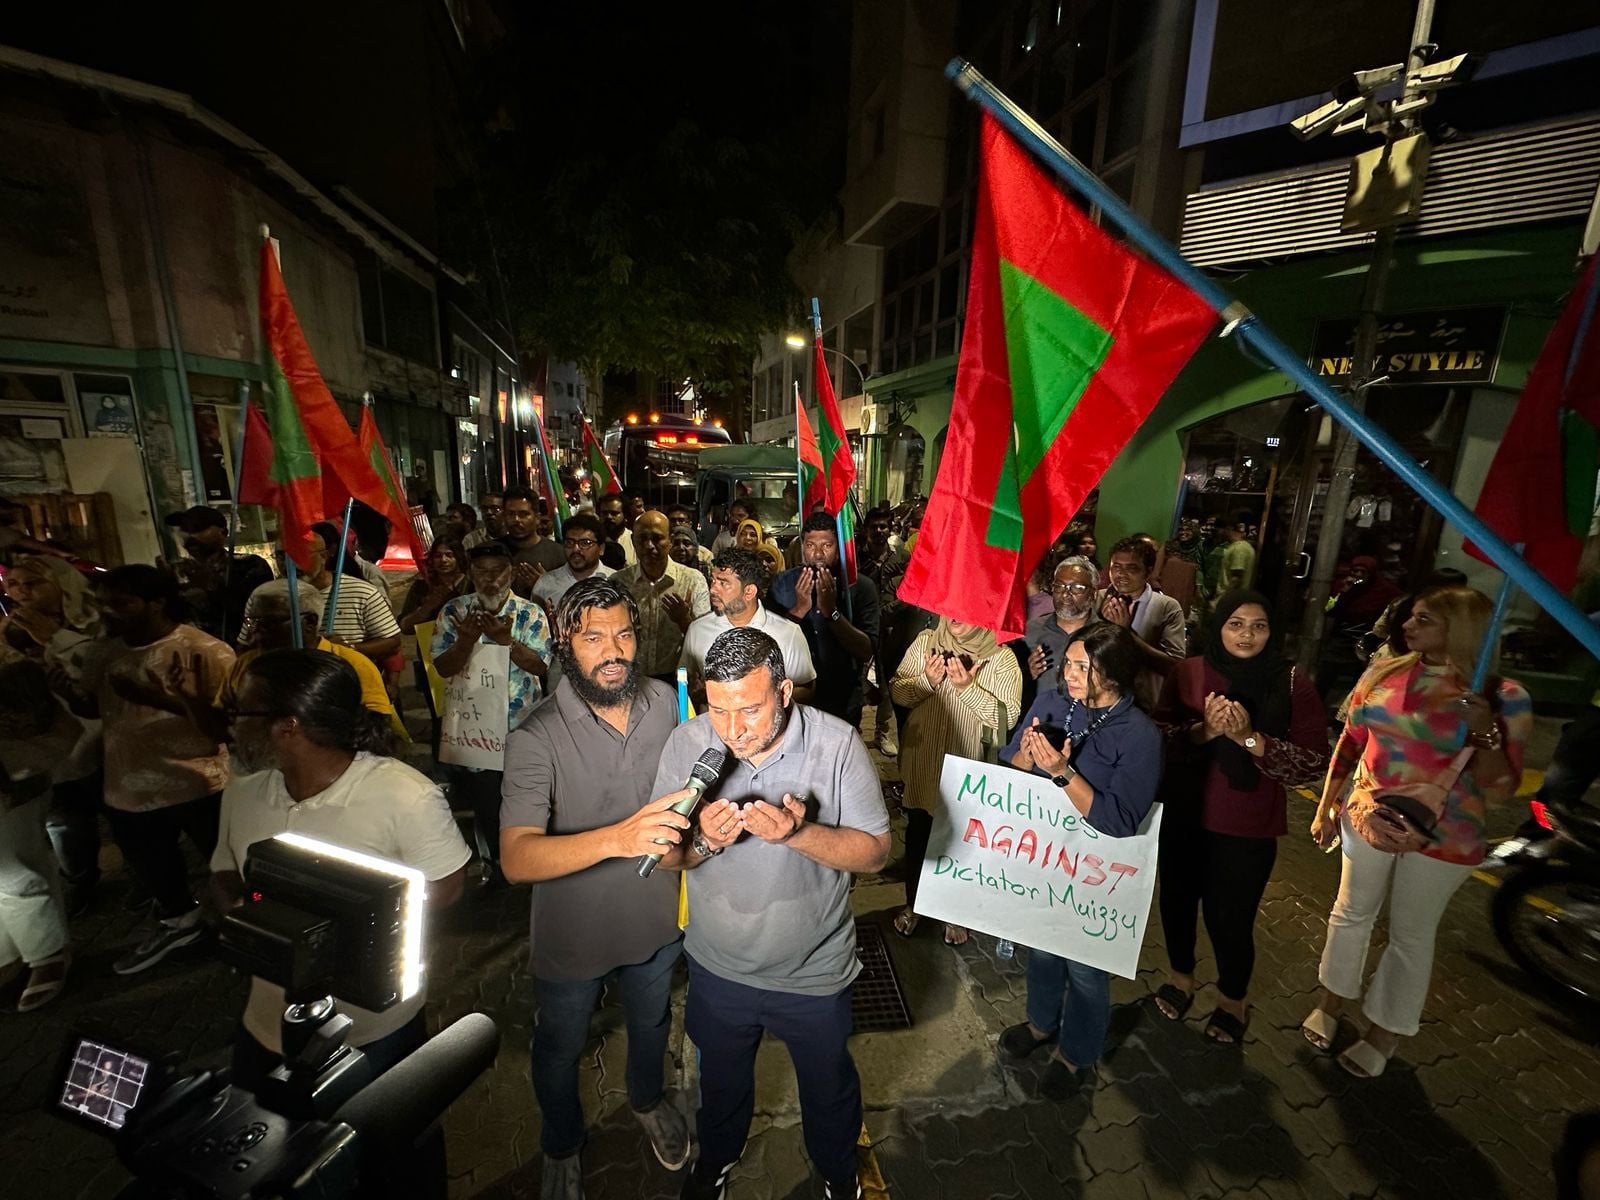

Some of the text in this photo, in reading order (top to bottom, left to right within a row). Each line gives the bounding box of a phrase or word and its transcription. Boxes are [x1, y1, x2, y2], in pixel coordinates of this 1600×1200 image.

[1387, 350, 1486, 373] STYLE
[957, 773, 1099, 839] Maldives
[934, 855, 1040, 900] Dictator
[963, 818, 1138, 896] AGAINST
